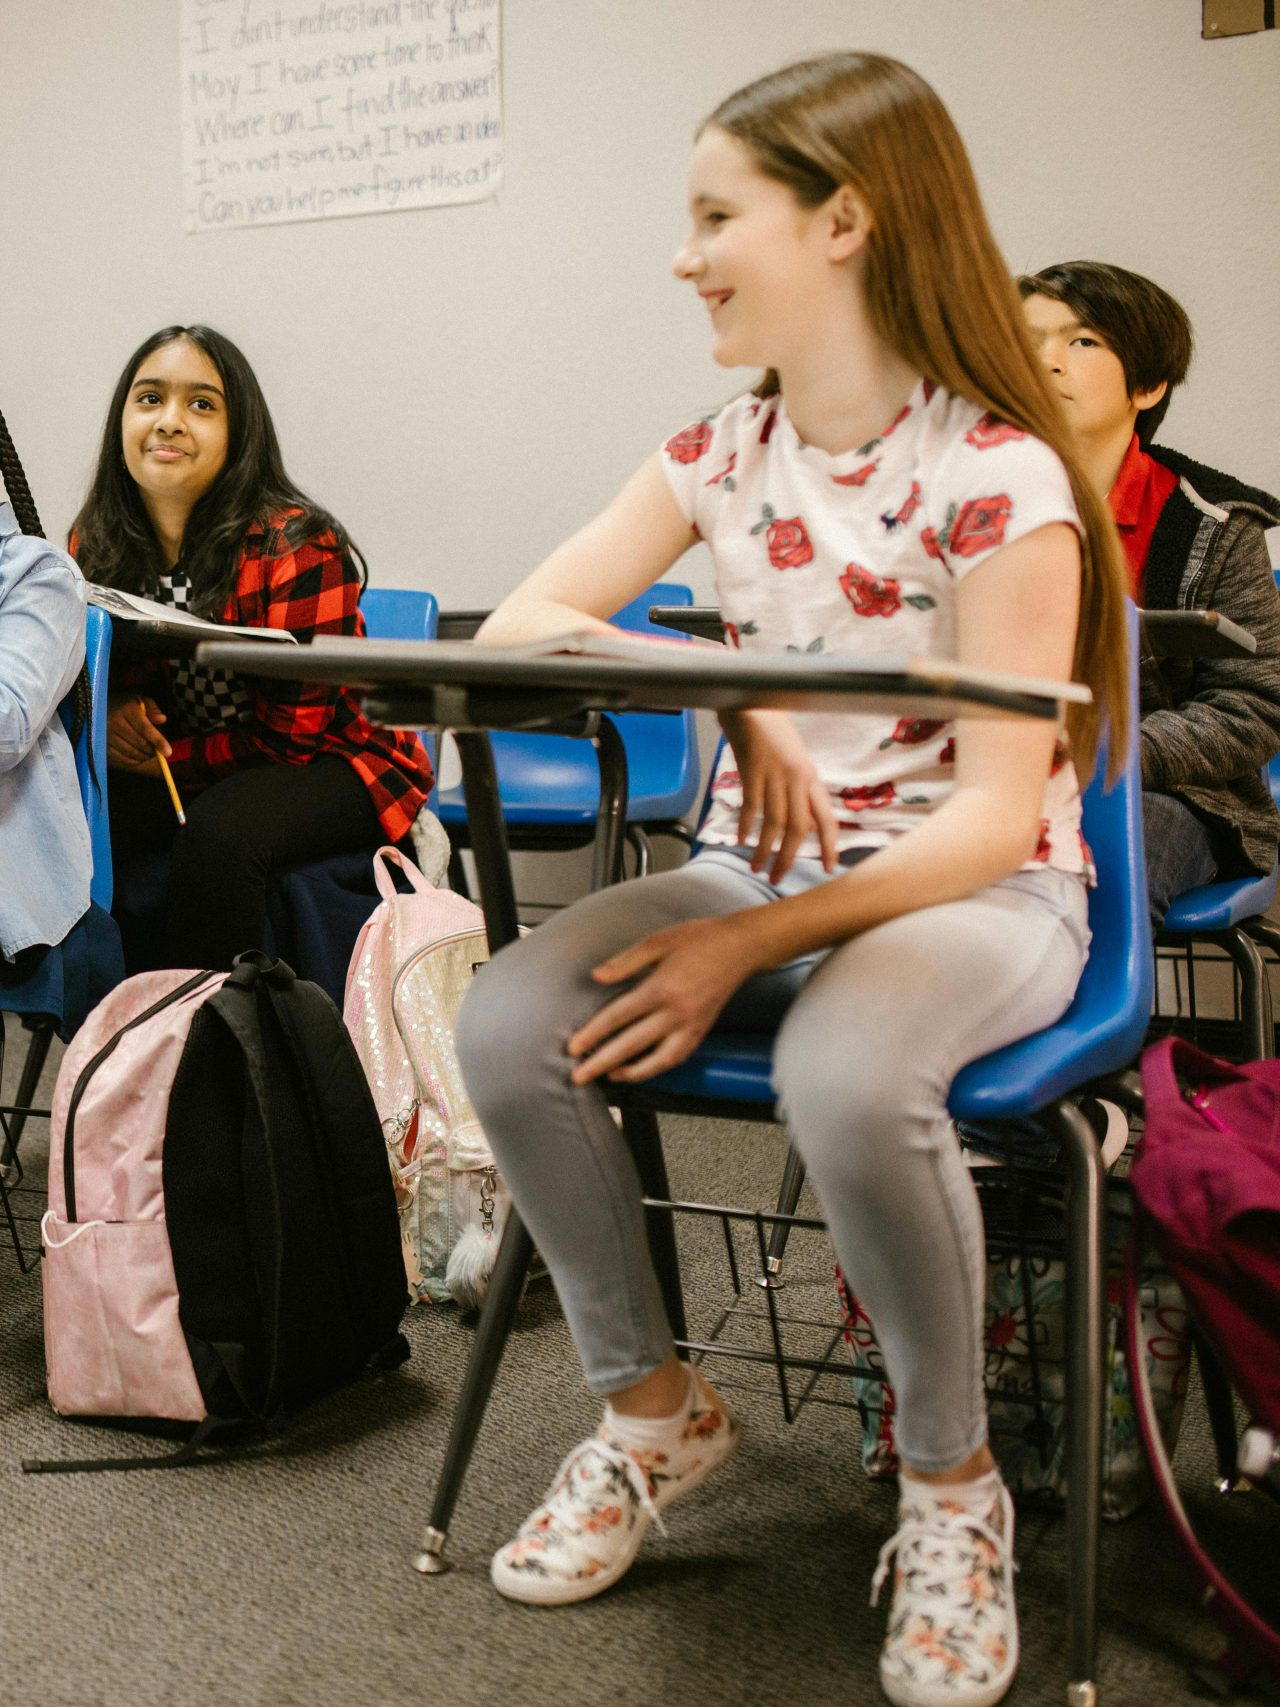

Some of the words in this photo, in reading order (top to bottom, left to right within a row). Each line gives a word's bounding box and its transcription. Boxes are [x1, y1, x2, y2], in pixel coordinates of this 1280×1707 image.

[246, 61, 270, 95] I
[308, 96, 335, 132] I
[377, 125, 401, 158] I
